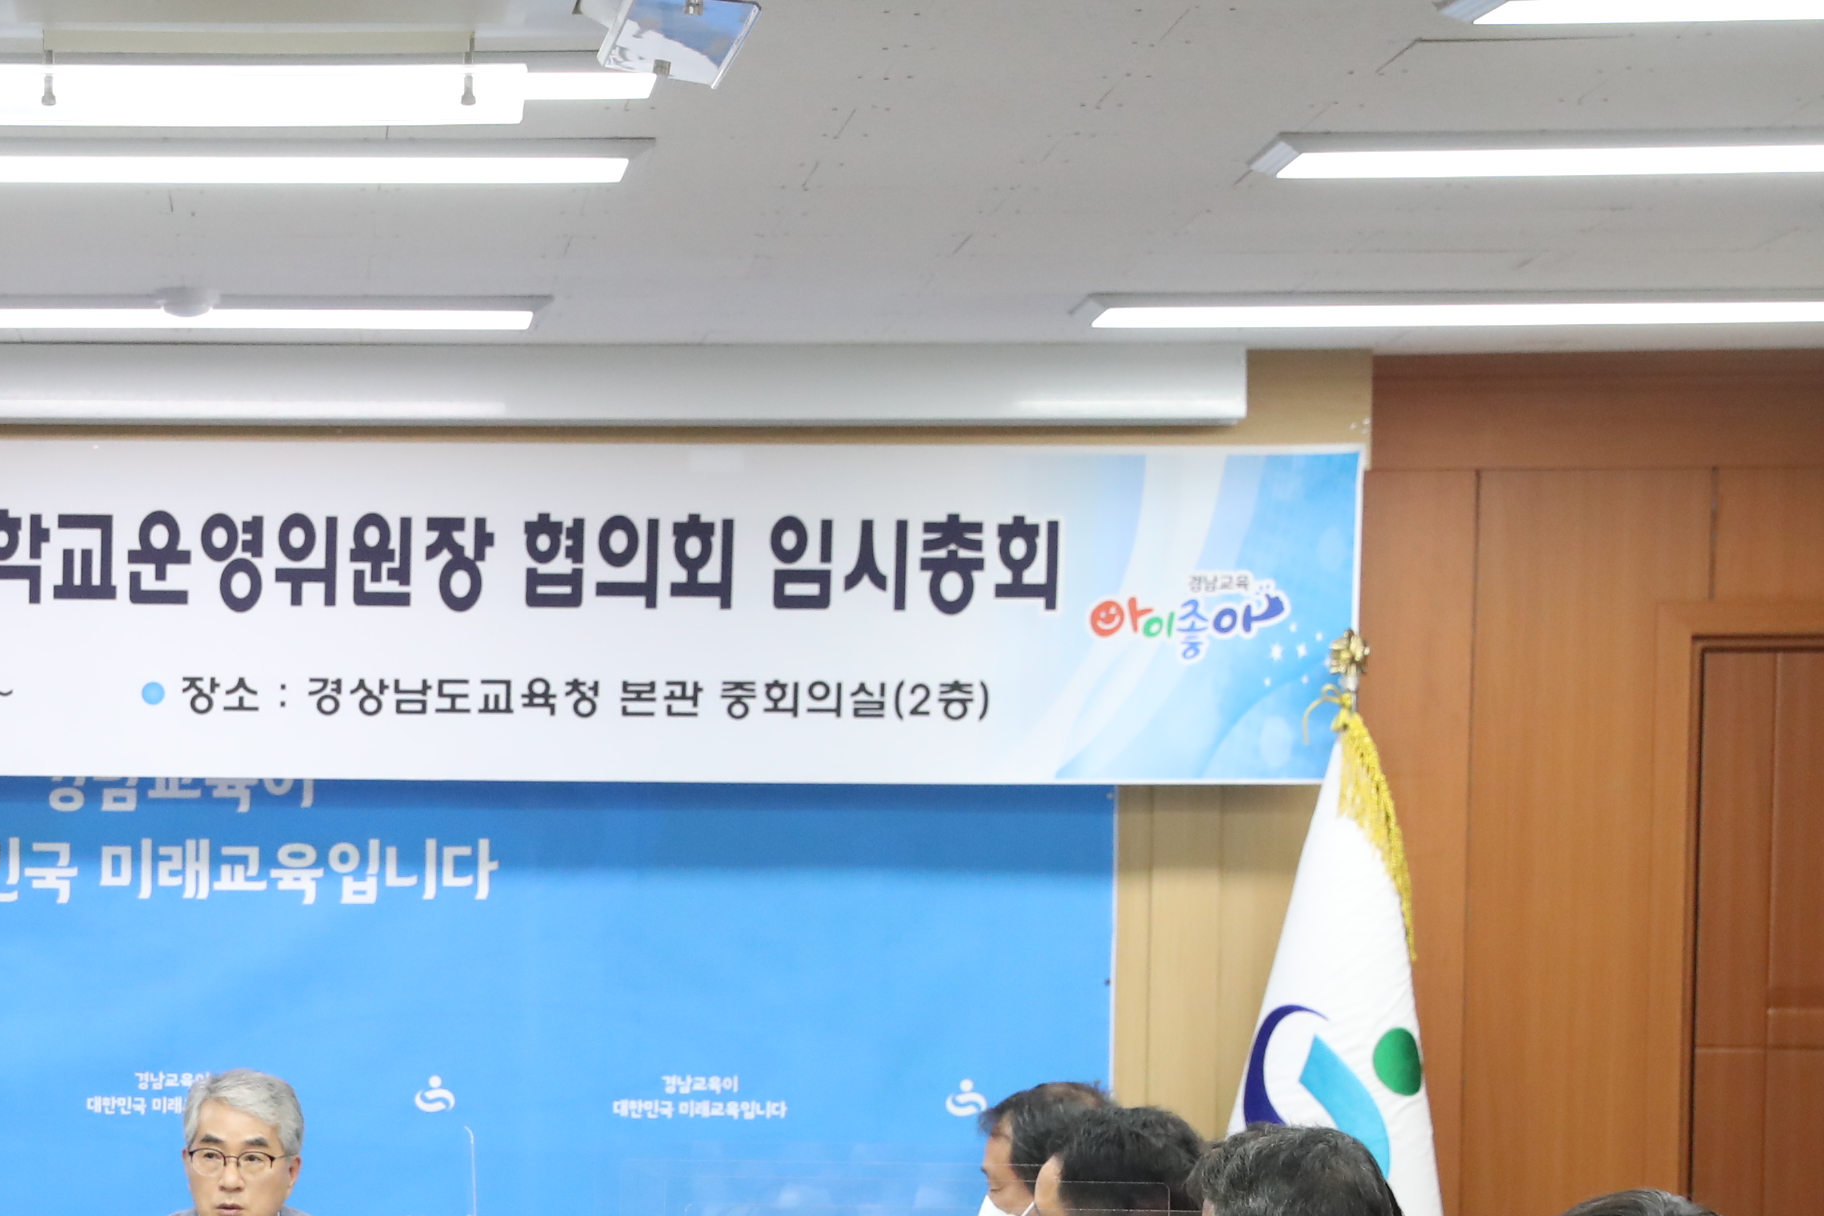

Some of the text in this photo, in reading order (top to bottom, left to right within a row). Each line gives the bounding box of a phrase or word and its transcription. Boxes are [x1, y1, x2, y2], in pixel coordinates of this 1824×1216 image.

[524, 513, 734, 611] 협의회
[770, 513, 1061, 616] 임시총회
[1190, 575, 1250, 592] 경남교육
[1090, 594, 1285, 660] 아이좋아
[182, 675, 259, 715] 장소
[308, 676, 600, 719] 경상남도교육청
[620, 679, 704, 717] 본관
[720, 679, 992, 721] 중회의실(2층)
[99, 838, 500, 905] 미래교육입니다
[661, 1075, 739, 1094] 경남교육이
[86, 1095, 147, 1115] 대한민국
[612, 1099, 788, 1120] 대한민국 미래교육입니다
